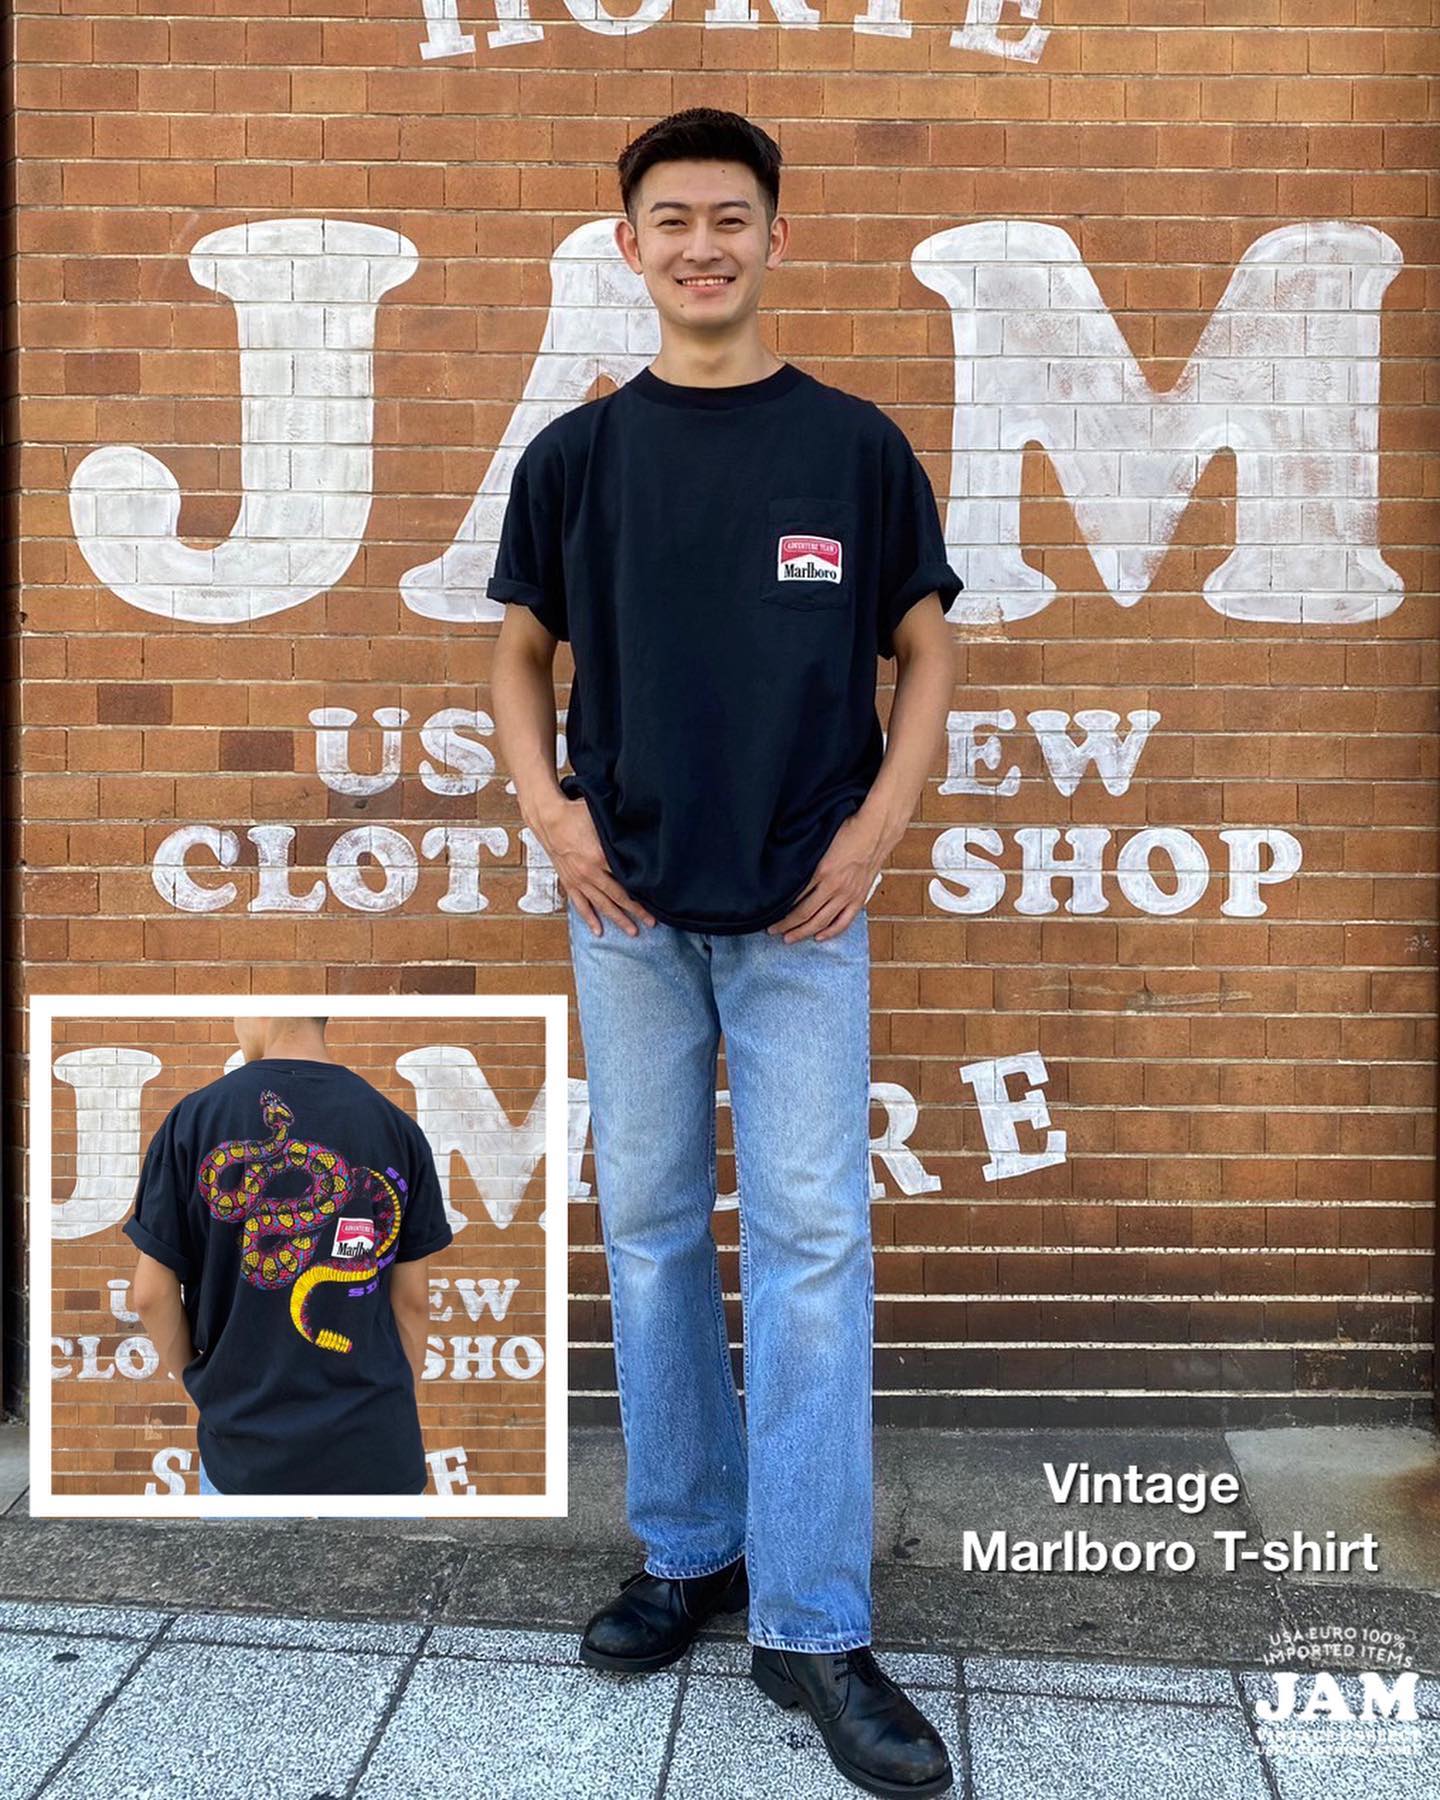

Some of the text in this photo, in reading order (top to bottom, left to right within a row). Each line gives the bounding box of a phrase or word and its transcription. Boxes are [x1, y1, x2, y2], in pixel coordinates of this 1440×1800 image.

[784, 562, 837, 580] Marlboro
[938, 708, 1162, 797] EW
[928, 827, 1304, 918] SHOP
[421, 1337, 545, 1381] SHO
